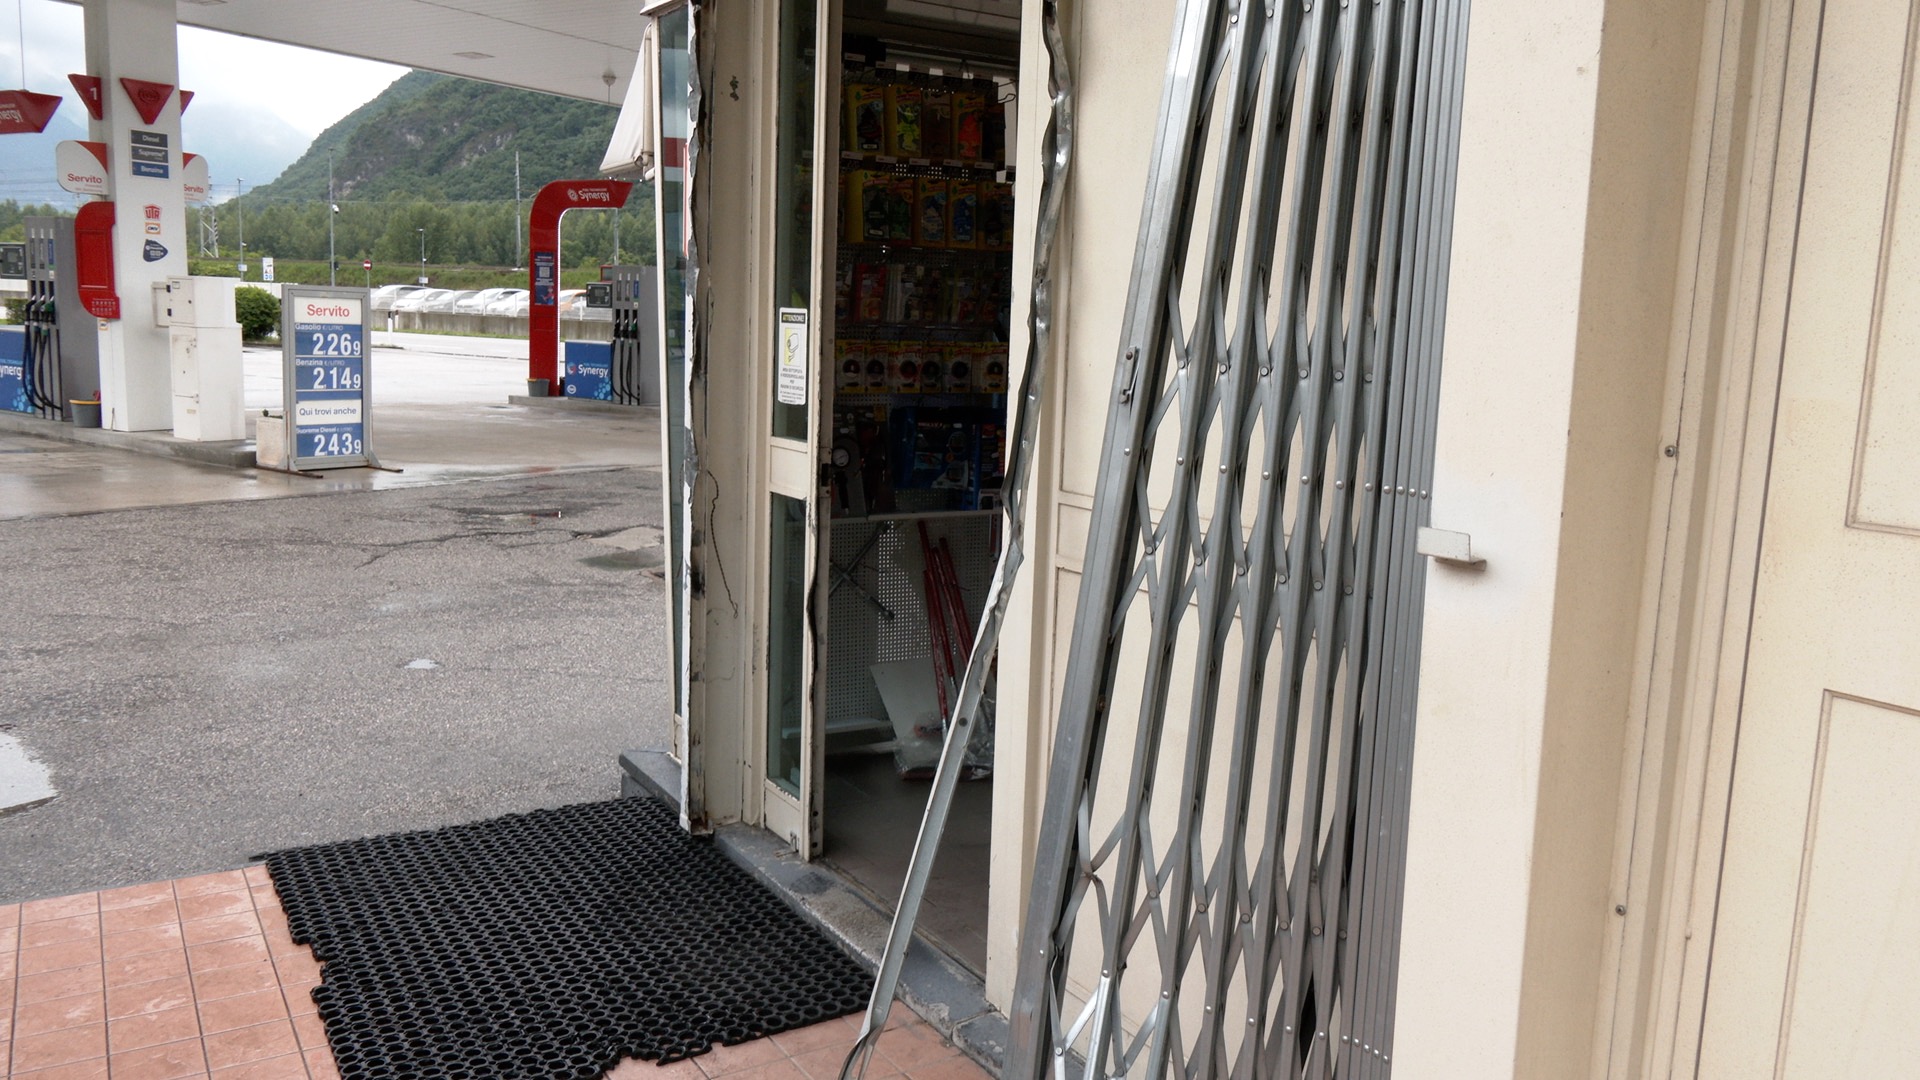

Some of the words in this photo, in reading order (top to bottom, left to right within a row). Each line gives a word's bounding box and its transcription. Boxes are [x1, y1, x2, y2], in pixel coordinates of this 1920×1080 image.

[90, 87, 97, 100] 1
[0, 109, 24, 123] nergy
[67, 173, 103, 184] Servito
[184, 183, 204, 194] Servito
[578, 190, 610, 202] Synergy
[307, 303, 350, 317] Servito
[295, 323, 321, 331] Gasolio
[295, 358, 323, 366] Benzina
[0, 365, 23, 380] ynerg
[578, 364, 608, 378] Synergy
[299, 407, 313, 416] Qui
[314, 407, 332, 415] trovi
[333, 407, 357, 415] anche
